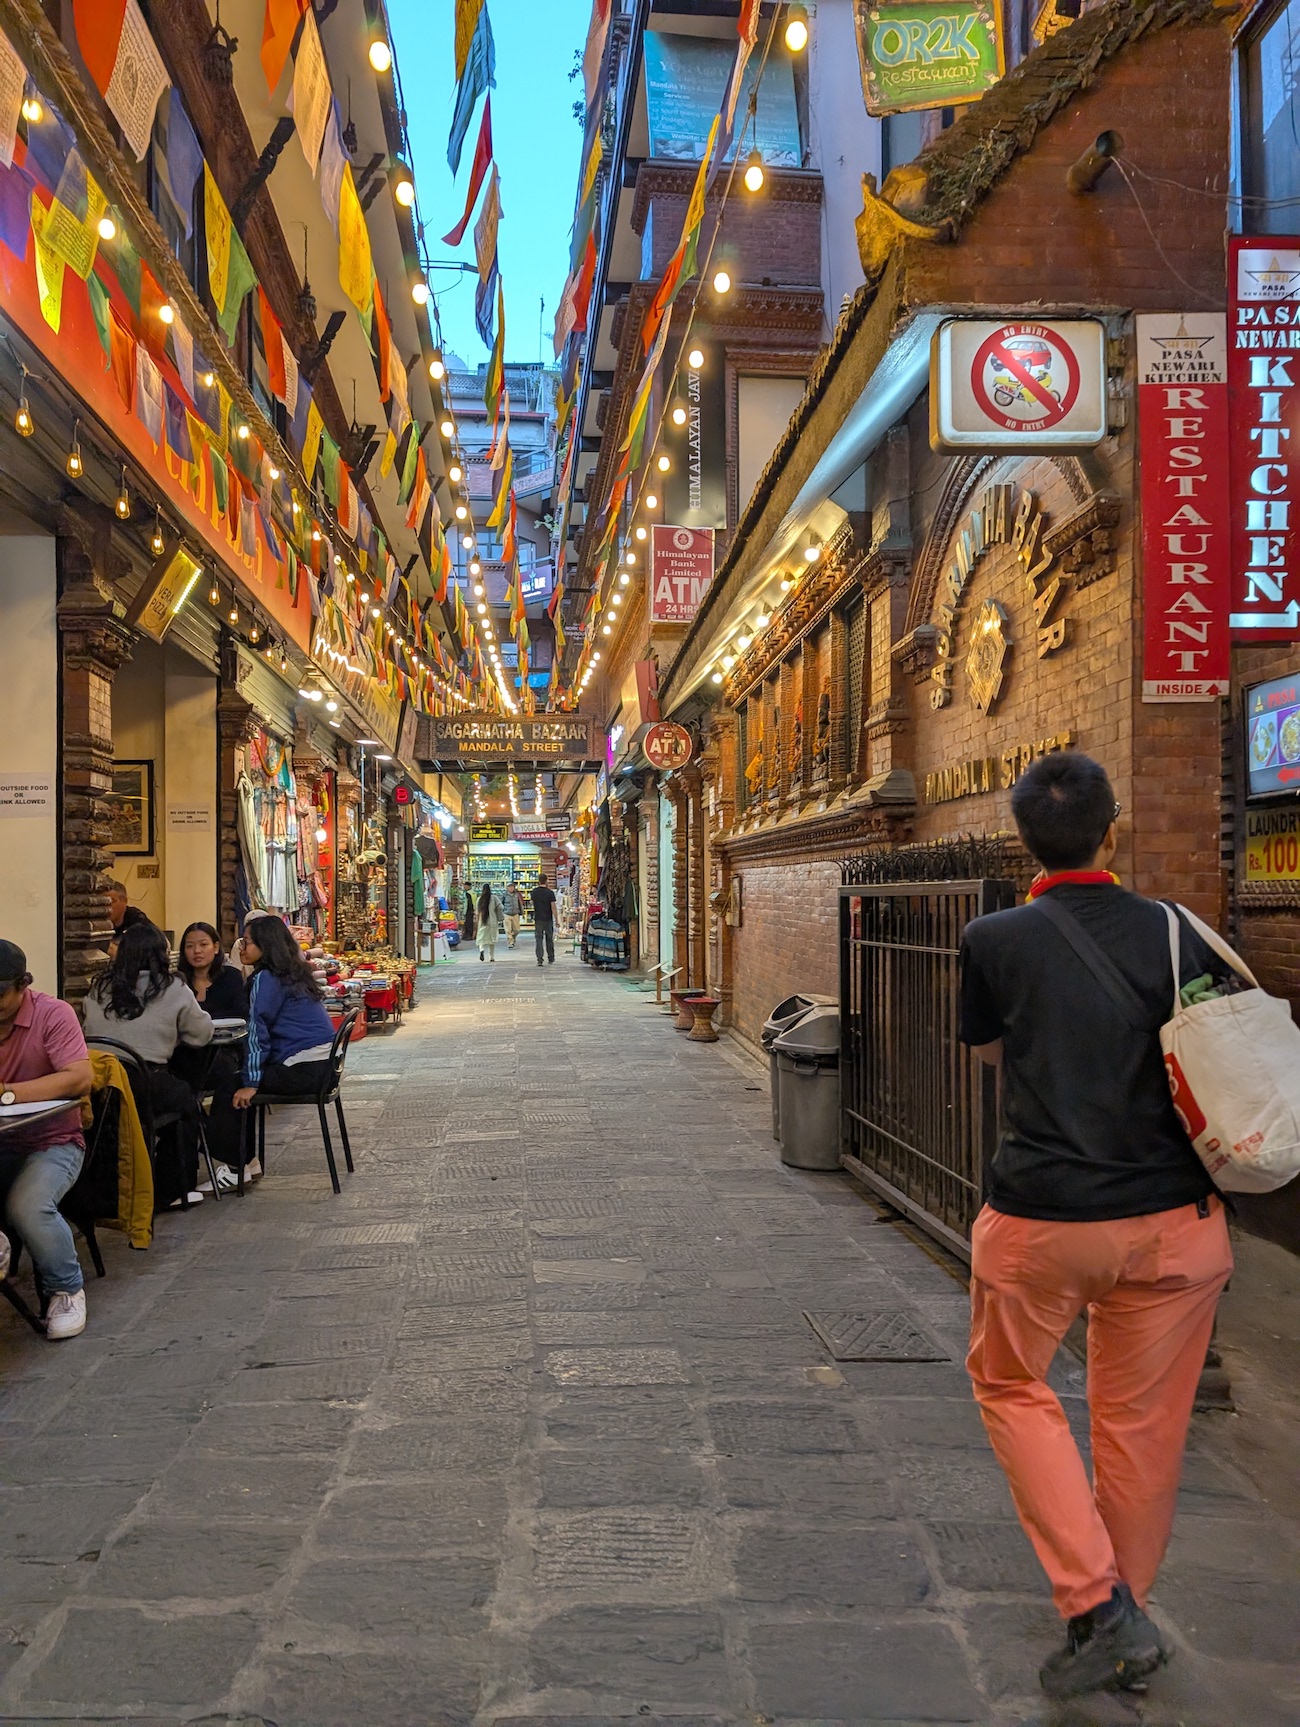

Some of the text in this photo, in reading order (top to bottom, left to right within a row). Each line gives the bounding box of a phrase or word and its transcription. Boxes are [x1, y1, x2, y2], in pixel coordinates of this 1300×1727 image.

[872, 12, 980, 67] OR2K
[880, 59, 979, 87] Restaurant
[1002, 325, 1048, 338] NO ENTRY
[1162, 350, 1205, 360] PASA
[1151, 361, 1215, 372] NEWARI
[1145, 373, 1222, 383] KITCHEN
[1005, 419, 1046, 431] NO ENTRY
[688, 368, 701, 511] HIMALAYAN JAV
[1244, 356, 1295, 602] KITCHEN
[1162, 388, 1213, 672] RESTAURANT
[657, 550, 709, 560] Himalayan
[664, 569, 702, 577] Limited
[158, 585, 174, 603] VERA
[655, 576, 712, 604] ATM
[151, 598, 168, 618] PIZZA
[665, 604, 678, 613] 24
[1157, 684, 1202, 694] INSIDE
[436, 723, 588, 740] SAGARMATHA BAZAAR
[459, 743, 566, 752] MANDALA STREET
[1249, 812, 1300, 837] LAUNDR
[517, 832, 556, 840] PHARMACY
[1249, 836, 1298, 873] Rs. 100
